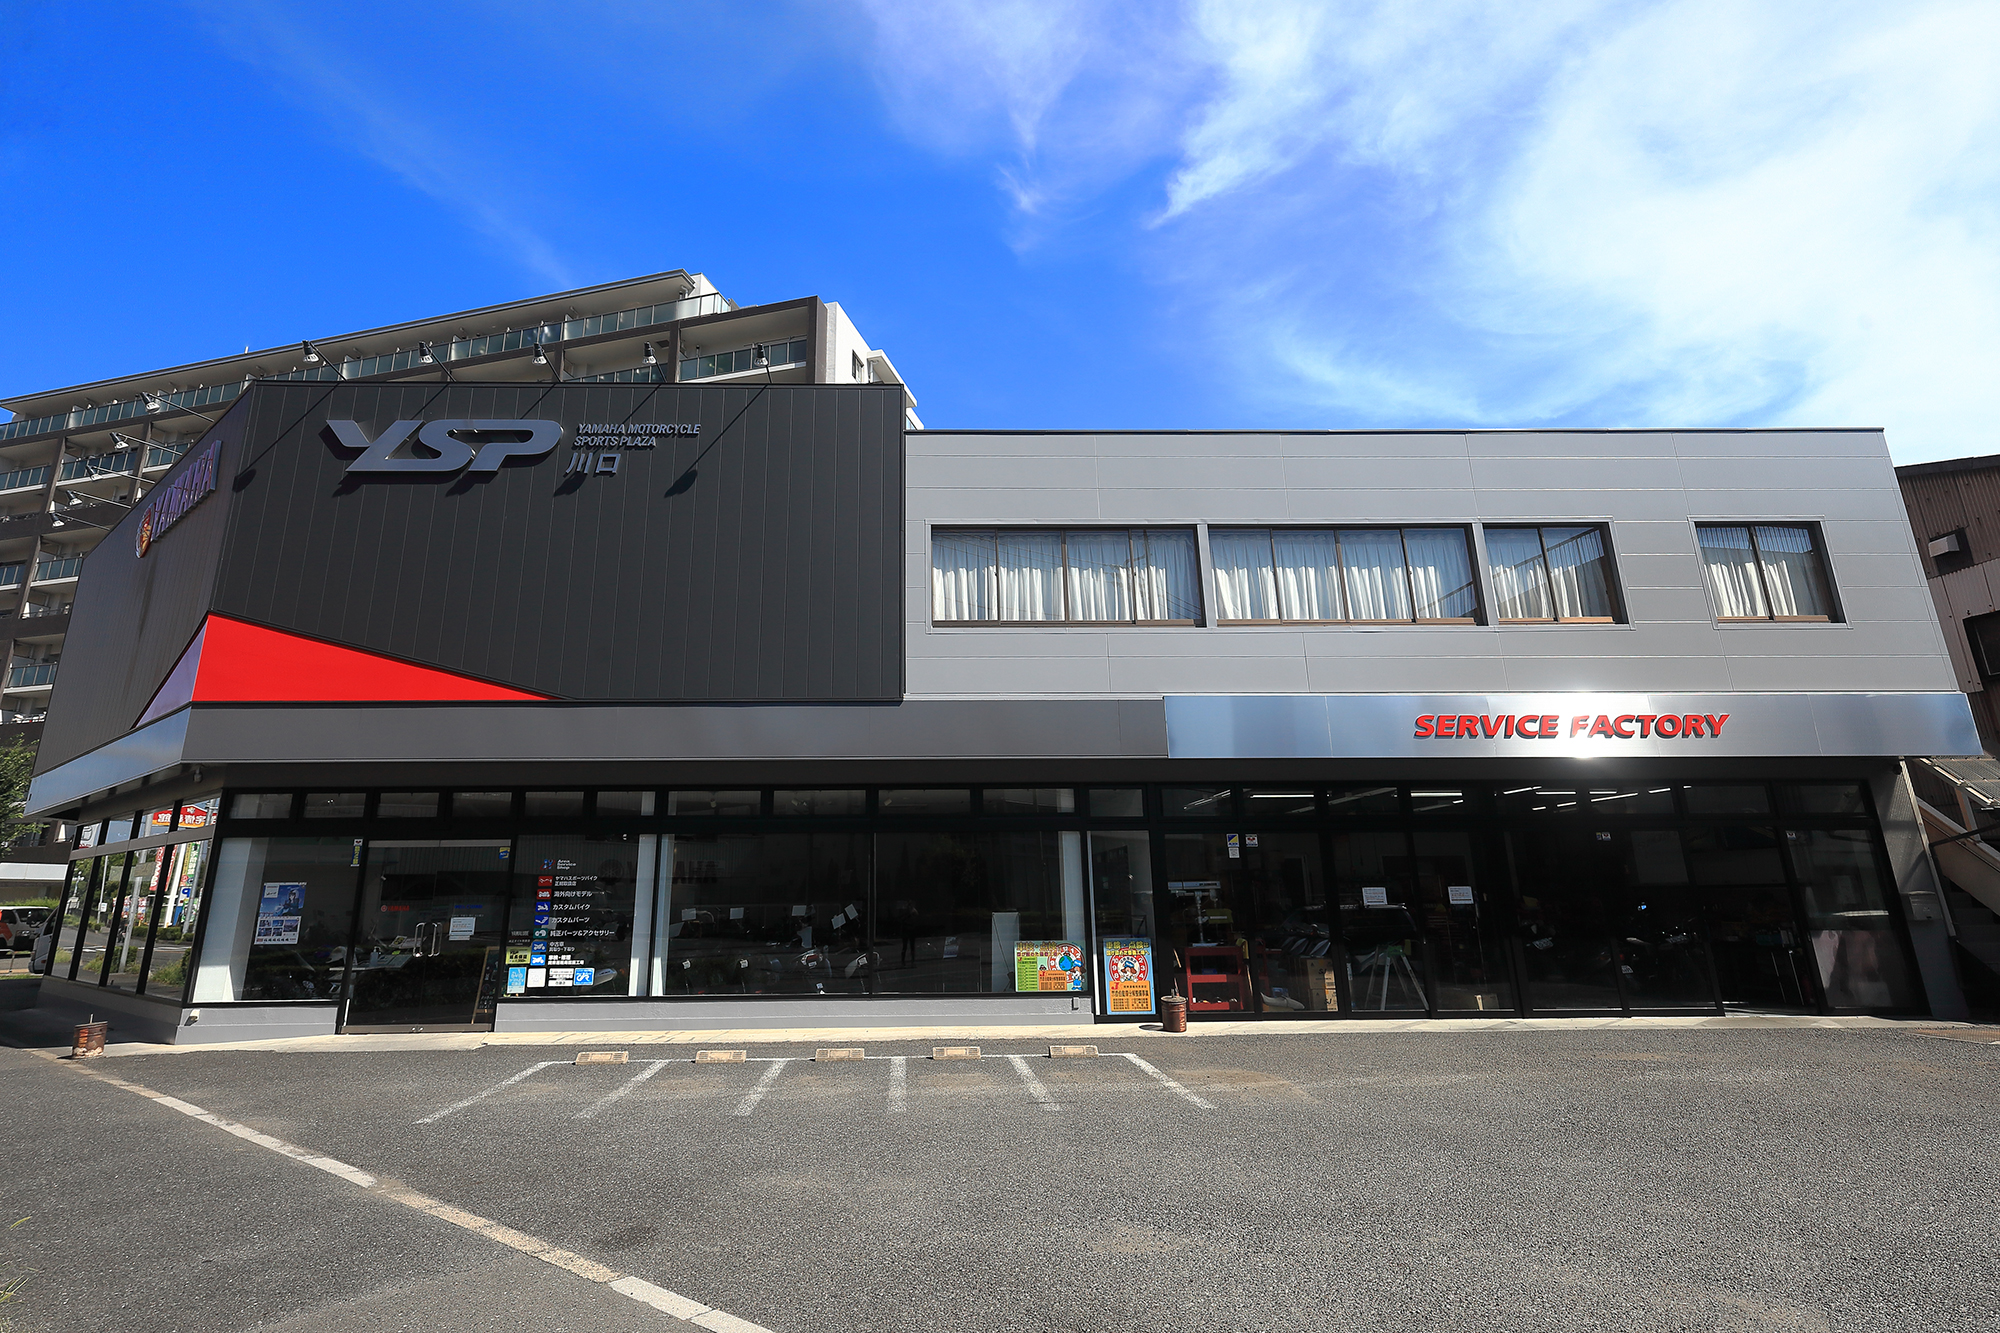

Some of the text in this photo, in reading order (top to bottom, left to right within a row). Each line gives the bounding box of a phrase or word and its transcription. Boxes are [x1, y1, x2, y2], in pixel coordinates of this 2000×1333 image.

[577, 422, 701, 436] YAMAHA MOTORCYCLE
[326, 419, 563, 472] YSP
[574, 435, 657, 448] SPORTS PLAZA
[565, 453, 622, 475] 川口
[152, 439, 222, 541] YAMAHA
[1413, 713, 1731, 740] SERVICE FACTORY
[553, 890, 593, 898] 海外向けモデル
[552, 903, 591, 911] カスタムバイク
[551, 916, 590, 924] カスタムパーツ
